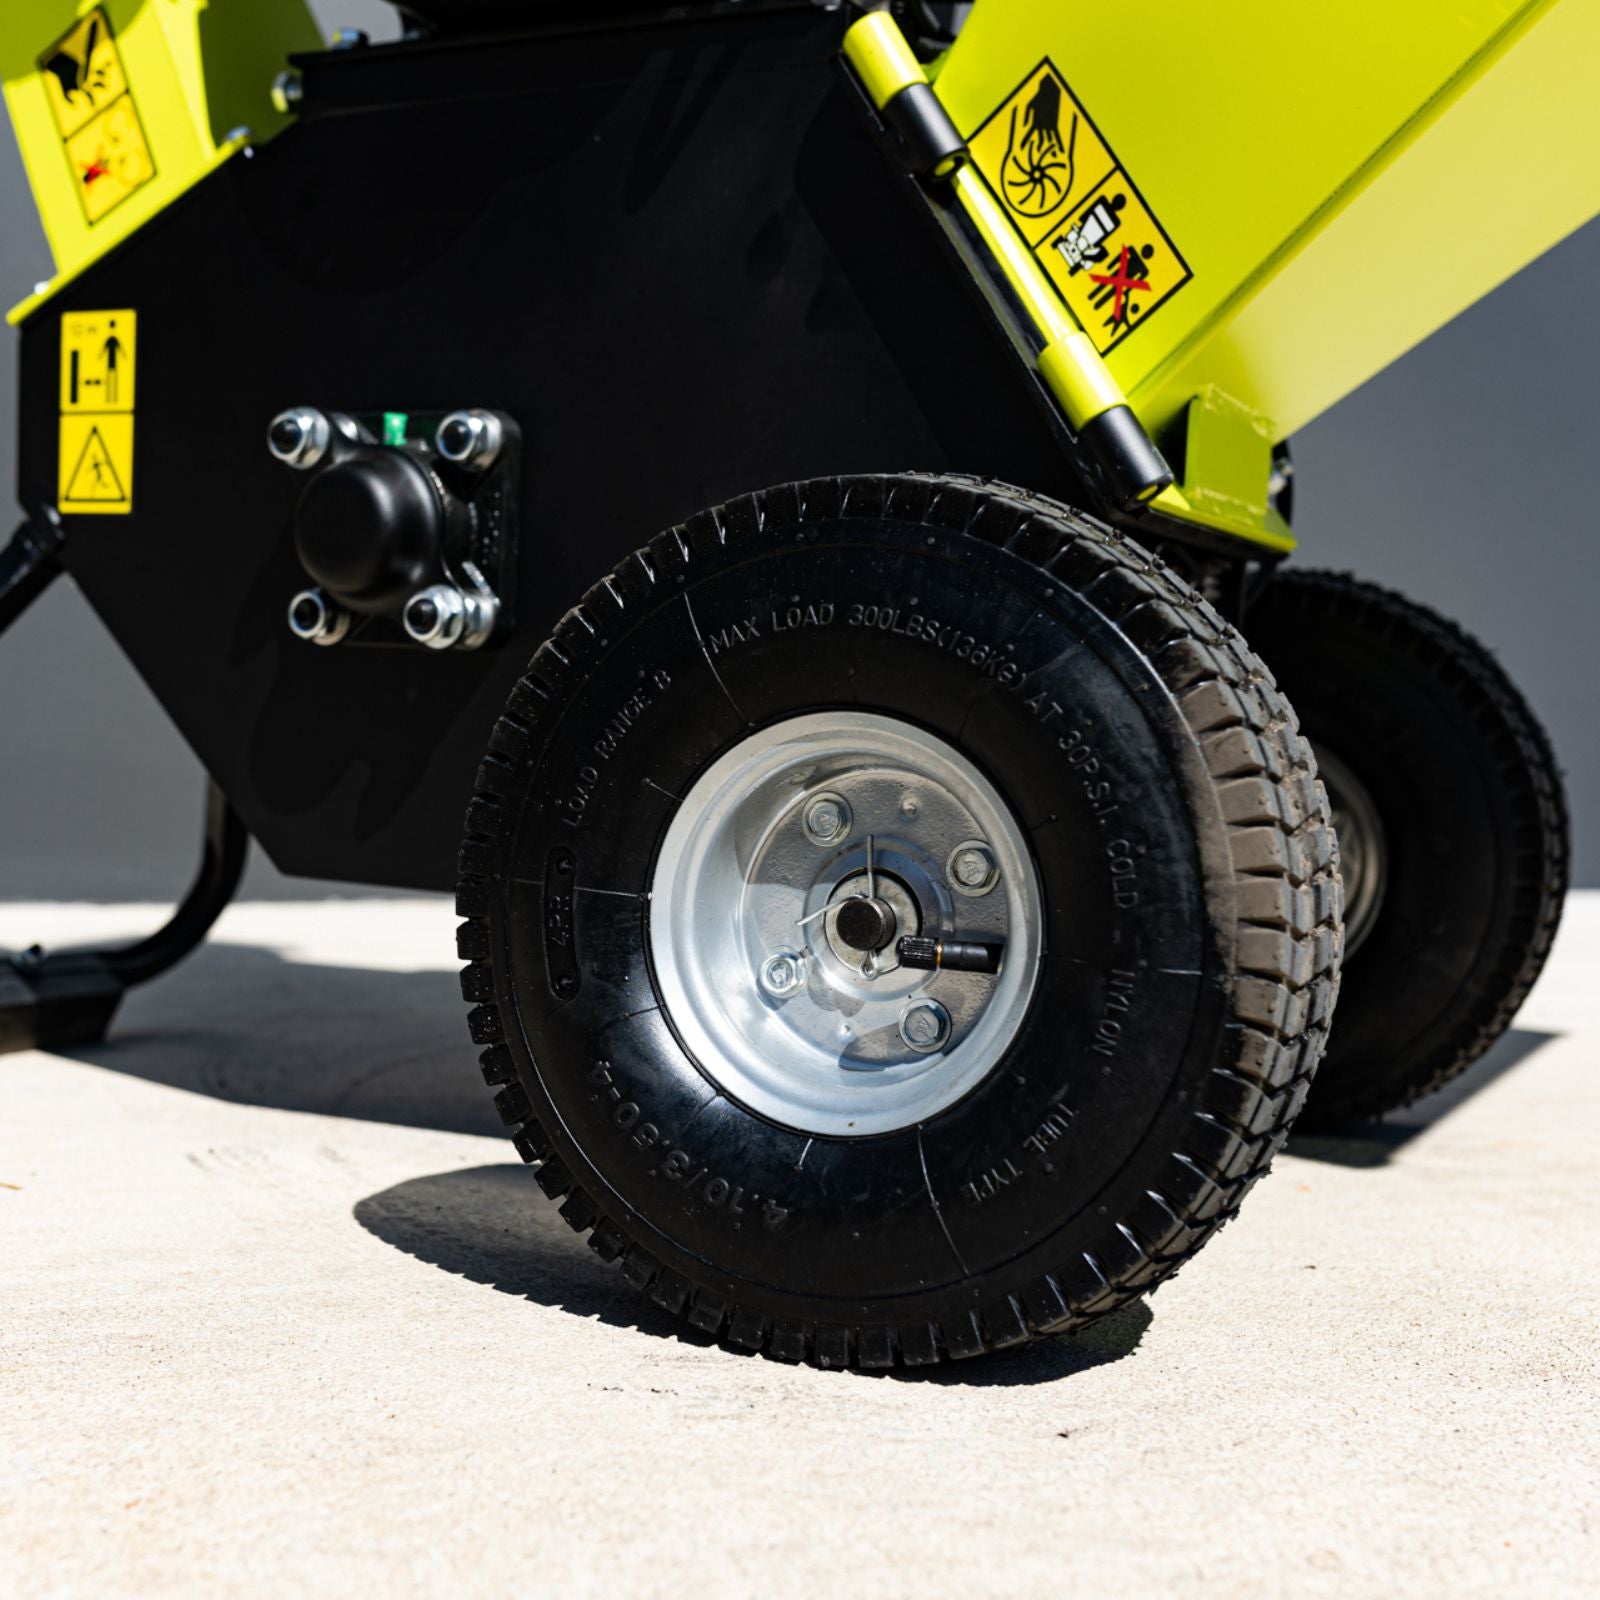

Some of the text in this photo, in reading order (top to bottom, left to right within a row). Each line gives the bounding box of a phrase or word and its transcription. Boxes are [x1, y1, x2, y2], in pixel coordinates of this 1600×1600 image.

[708, 616, 761, 655] MAX
[771, 603, 835, 633] LOAD
[1023, 691, 1065, 724] AT
[560, 765, 599, 828] LOAD
[593, 687, 653, 760] RANGE
[1105, 838, 1140, 910] COLD
[1090, 967, 1137, 1058] NYLON
[584, 1060, 789, 1232] 4.10/3.50-4
[960, 1101, 1081, 1203] TUBE TYPE
